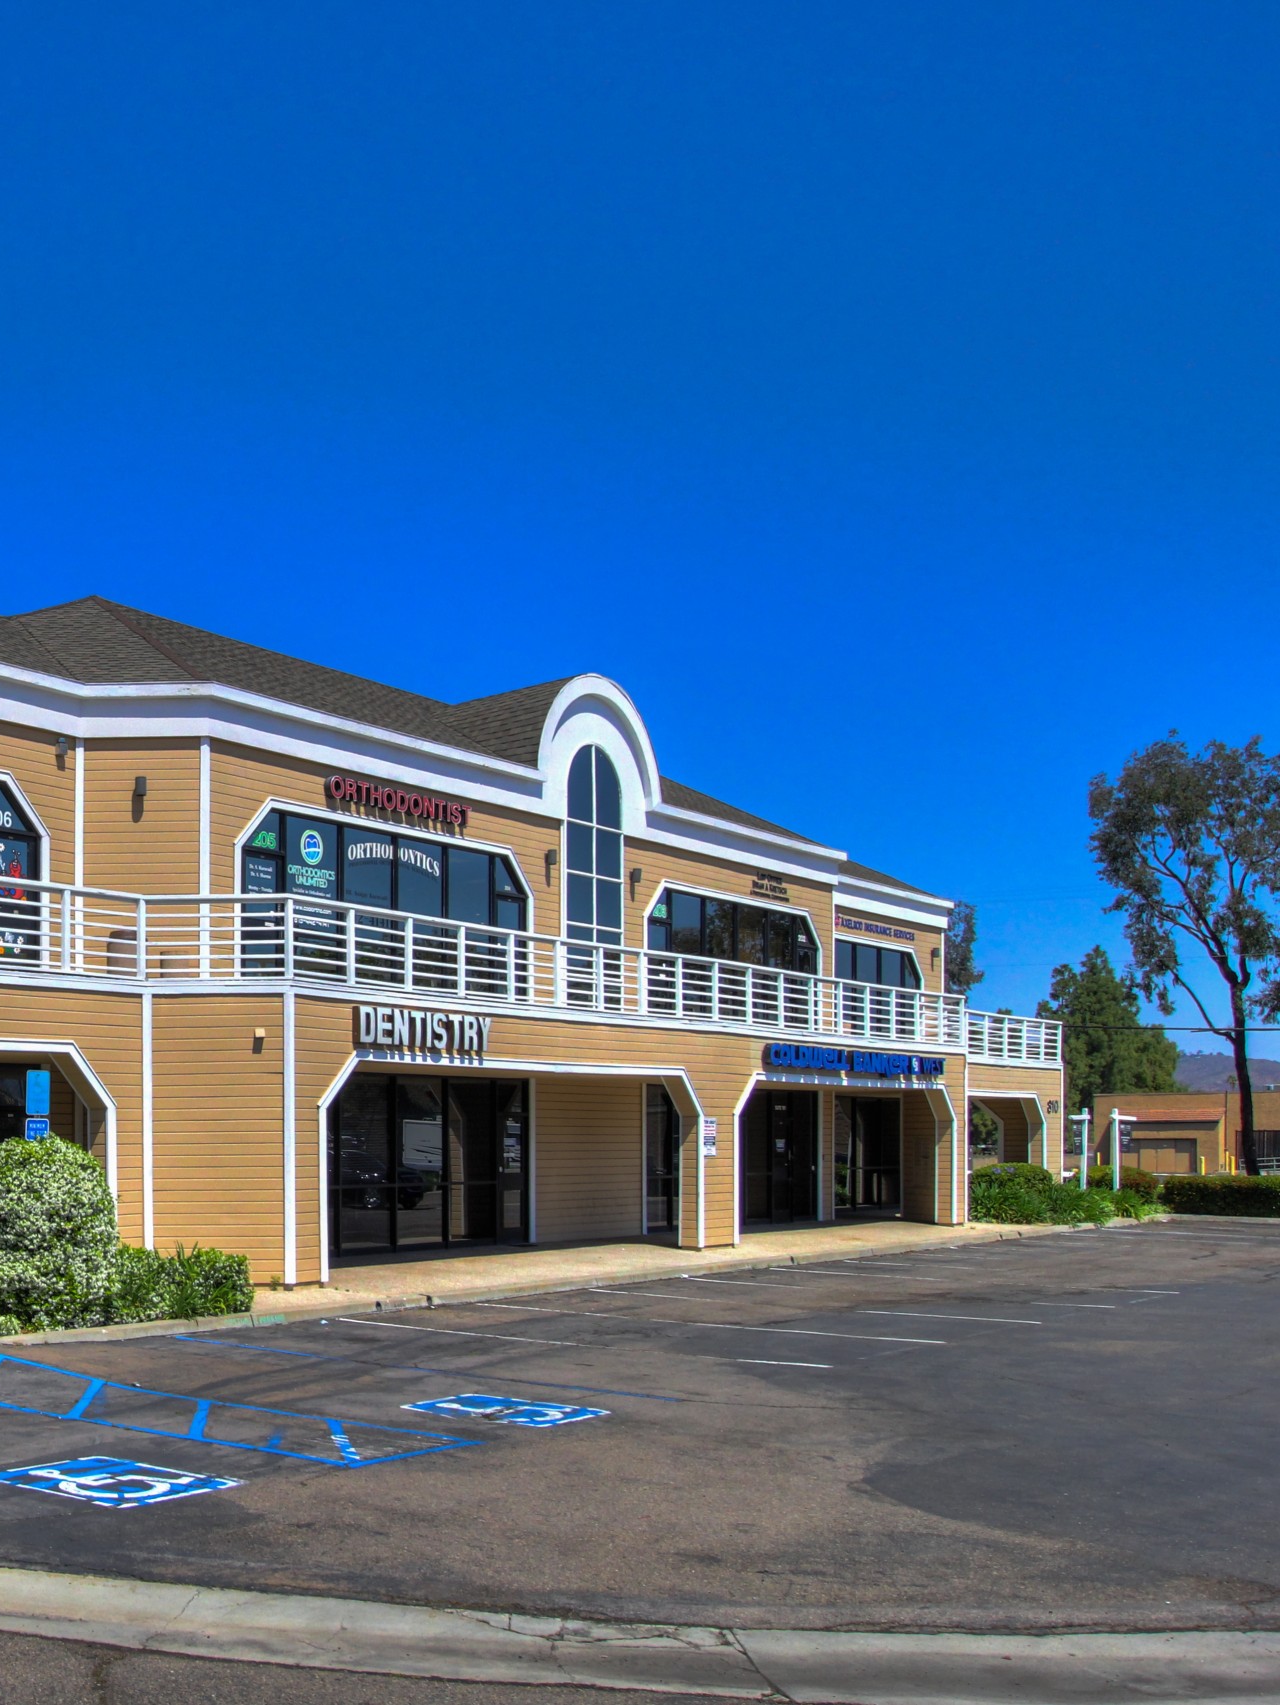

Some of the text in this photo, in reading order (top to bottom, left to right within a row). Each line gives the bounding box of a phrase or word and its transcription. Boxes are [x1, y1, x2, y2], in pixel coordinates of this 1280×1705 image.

[329, 775, 472, 825] ORTHODONTIST
[252, 830, 276, 849] 205
[287, 864, 335, 880] ORTHODONTICS
[295, 874, 328, 888] UNLIMITED
[357, 1005, 492, 1051] DENTISTRY
[771, 1042, 850, 1072] COLDWELL
[853, 1050, 909, 1078] BANKER
[922, 1058, 946, 1075] WEST
